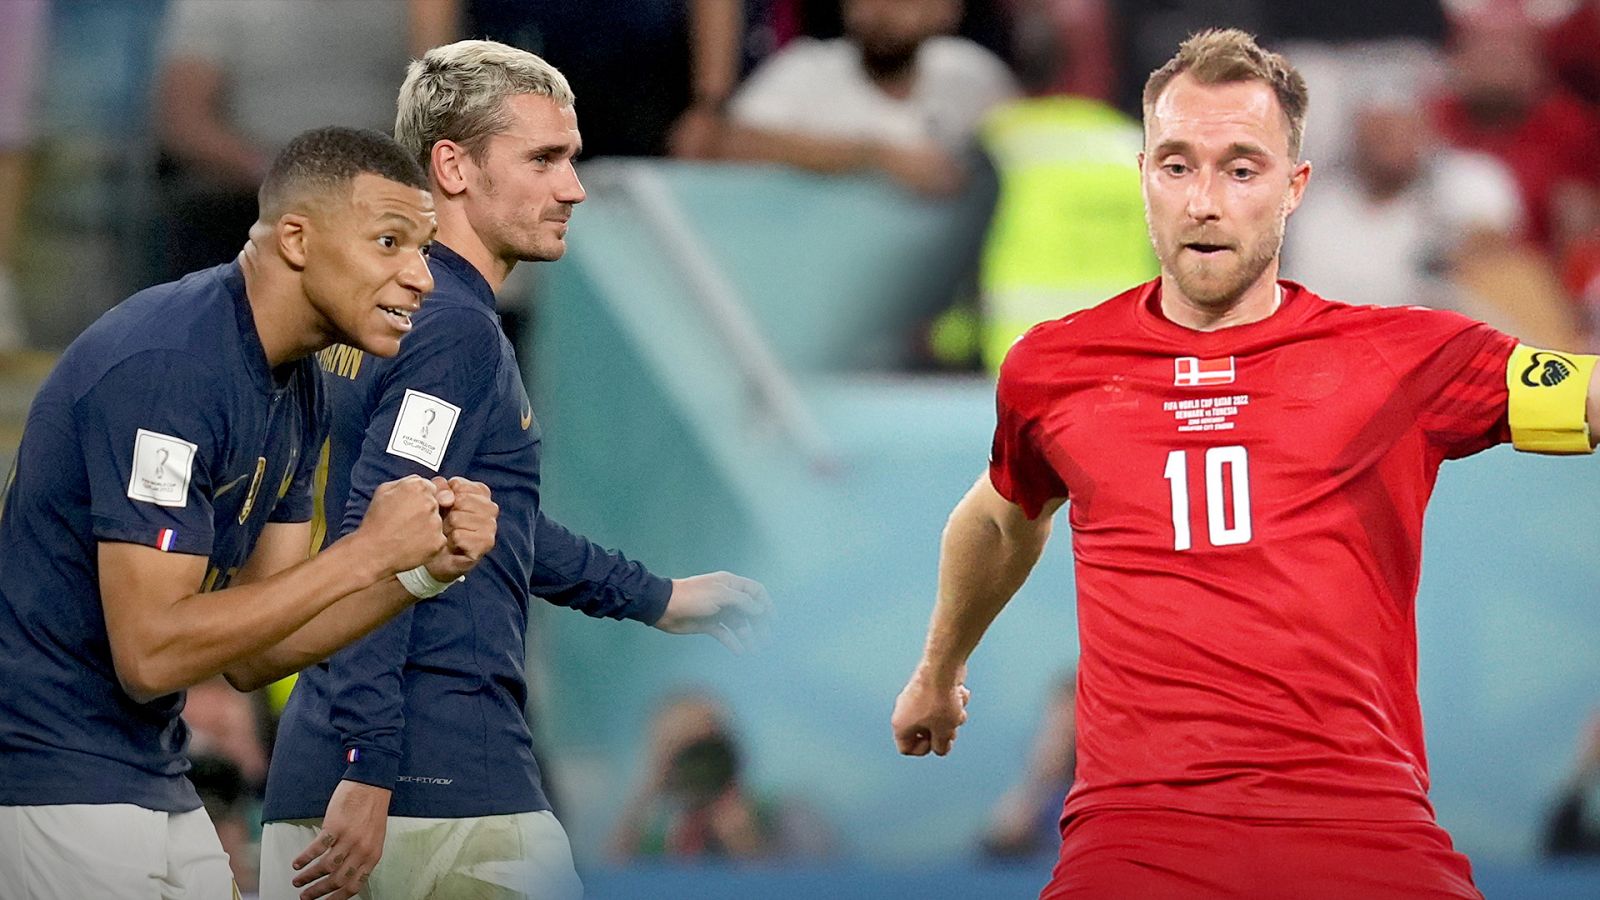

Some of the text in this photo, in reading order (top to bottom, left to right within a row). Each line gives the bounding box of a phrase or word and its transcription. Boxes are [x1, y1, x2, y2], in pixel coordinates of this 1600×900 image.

[1164, 401, 1178, 411] FIFA
[1179, 399, 1200, 410] WORLD
[1201, 398, 1213, 408] CUP
[1233, 395, 1249, 405] 2022
[1163, 445, 1252, 551] 10
